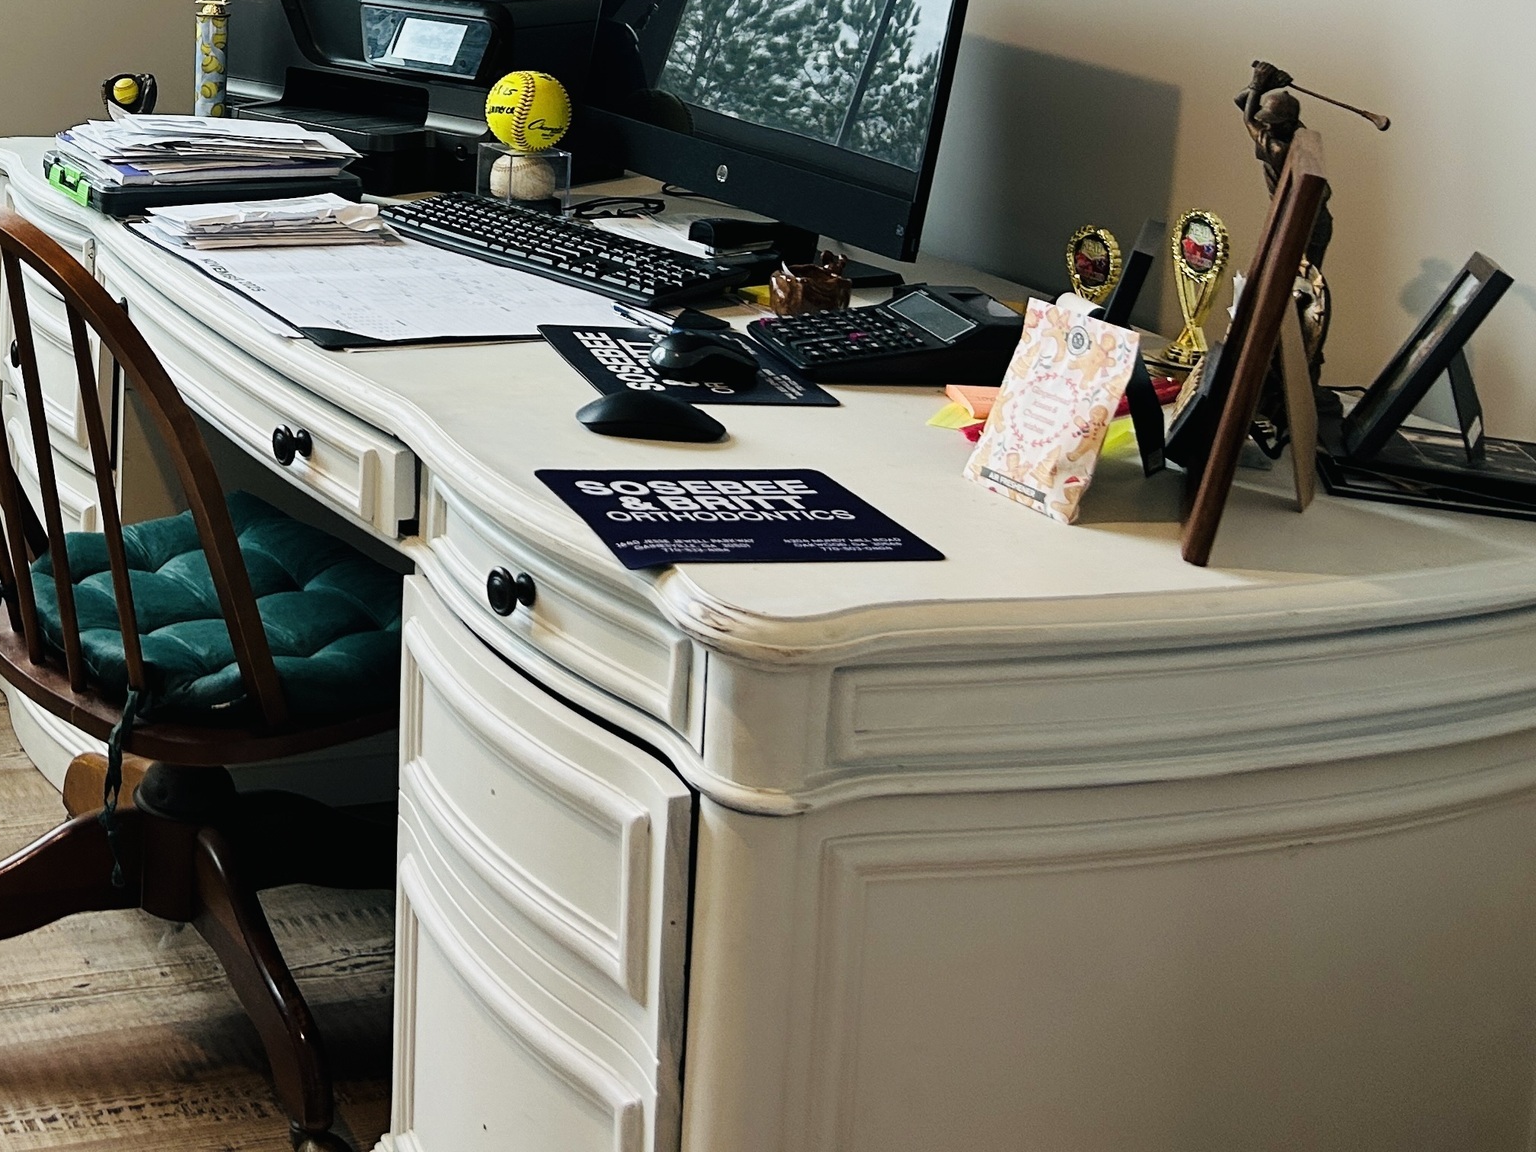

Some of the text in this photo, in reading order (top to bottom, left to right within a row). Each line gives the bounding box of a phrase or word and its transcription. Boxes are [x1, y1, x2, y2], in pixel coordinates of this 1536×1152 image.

[573, 330, 666, 391] SOSEBEE
[574, 480, 818, 496] SOSEBEE
[619, 495, 807, 511] & BRITT
[606, 509, 857, 523] ORTHODONTICS
